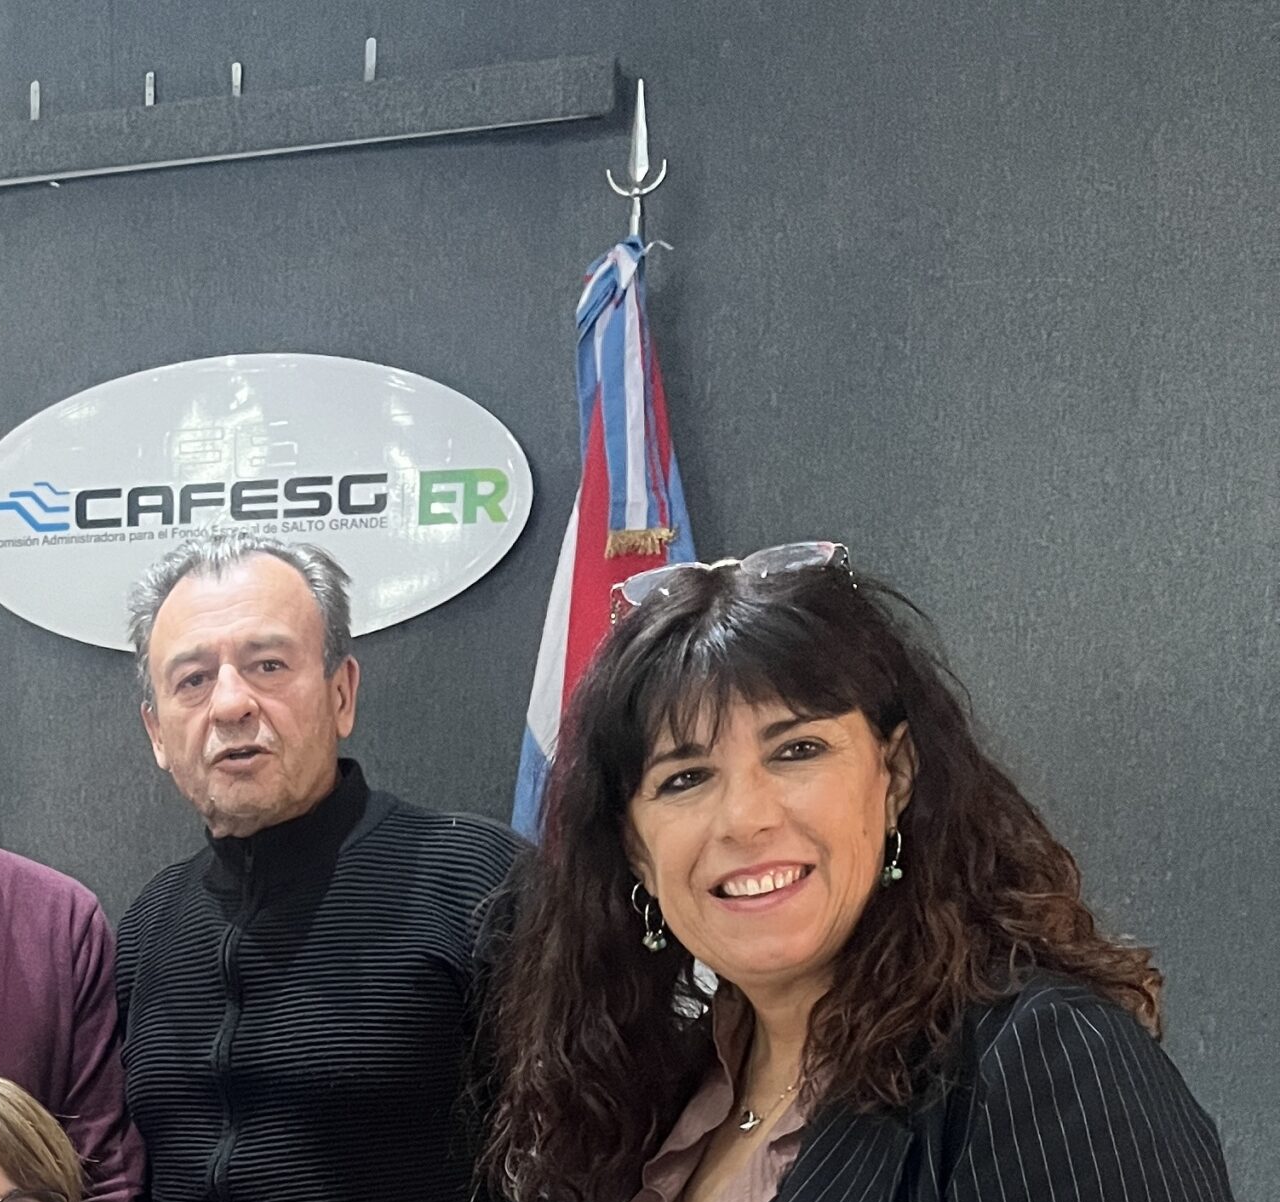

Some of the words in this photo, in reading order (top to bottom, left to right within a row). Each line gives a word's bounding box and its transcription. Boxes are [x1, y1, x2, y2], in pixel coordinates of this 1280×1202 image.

[75, 472, 388, 530] CAFESG
[419, 467, 509, 527] ER
[41, 530, 126, 547] Administradora
[128, 531, 155, 543] para
[158, 528, 168, 540] el
[171, 527, 208, 540] Fondo
[263, 522, 278, 534] de
[281, 519, 326, 533] SALTO
[329, 516, 388, 530] GRANDE
